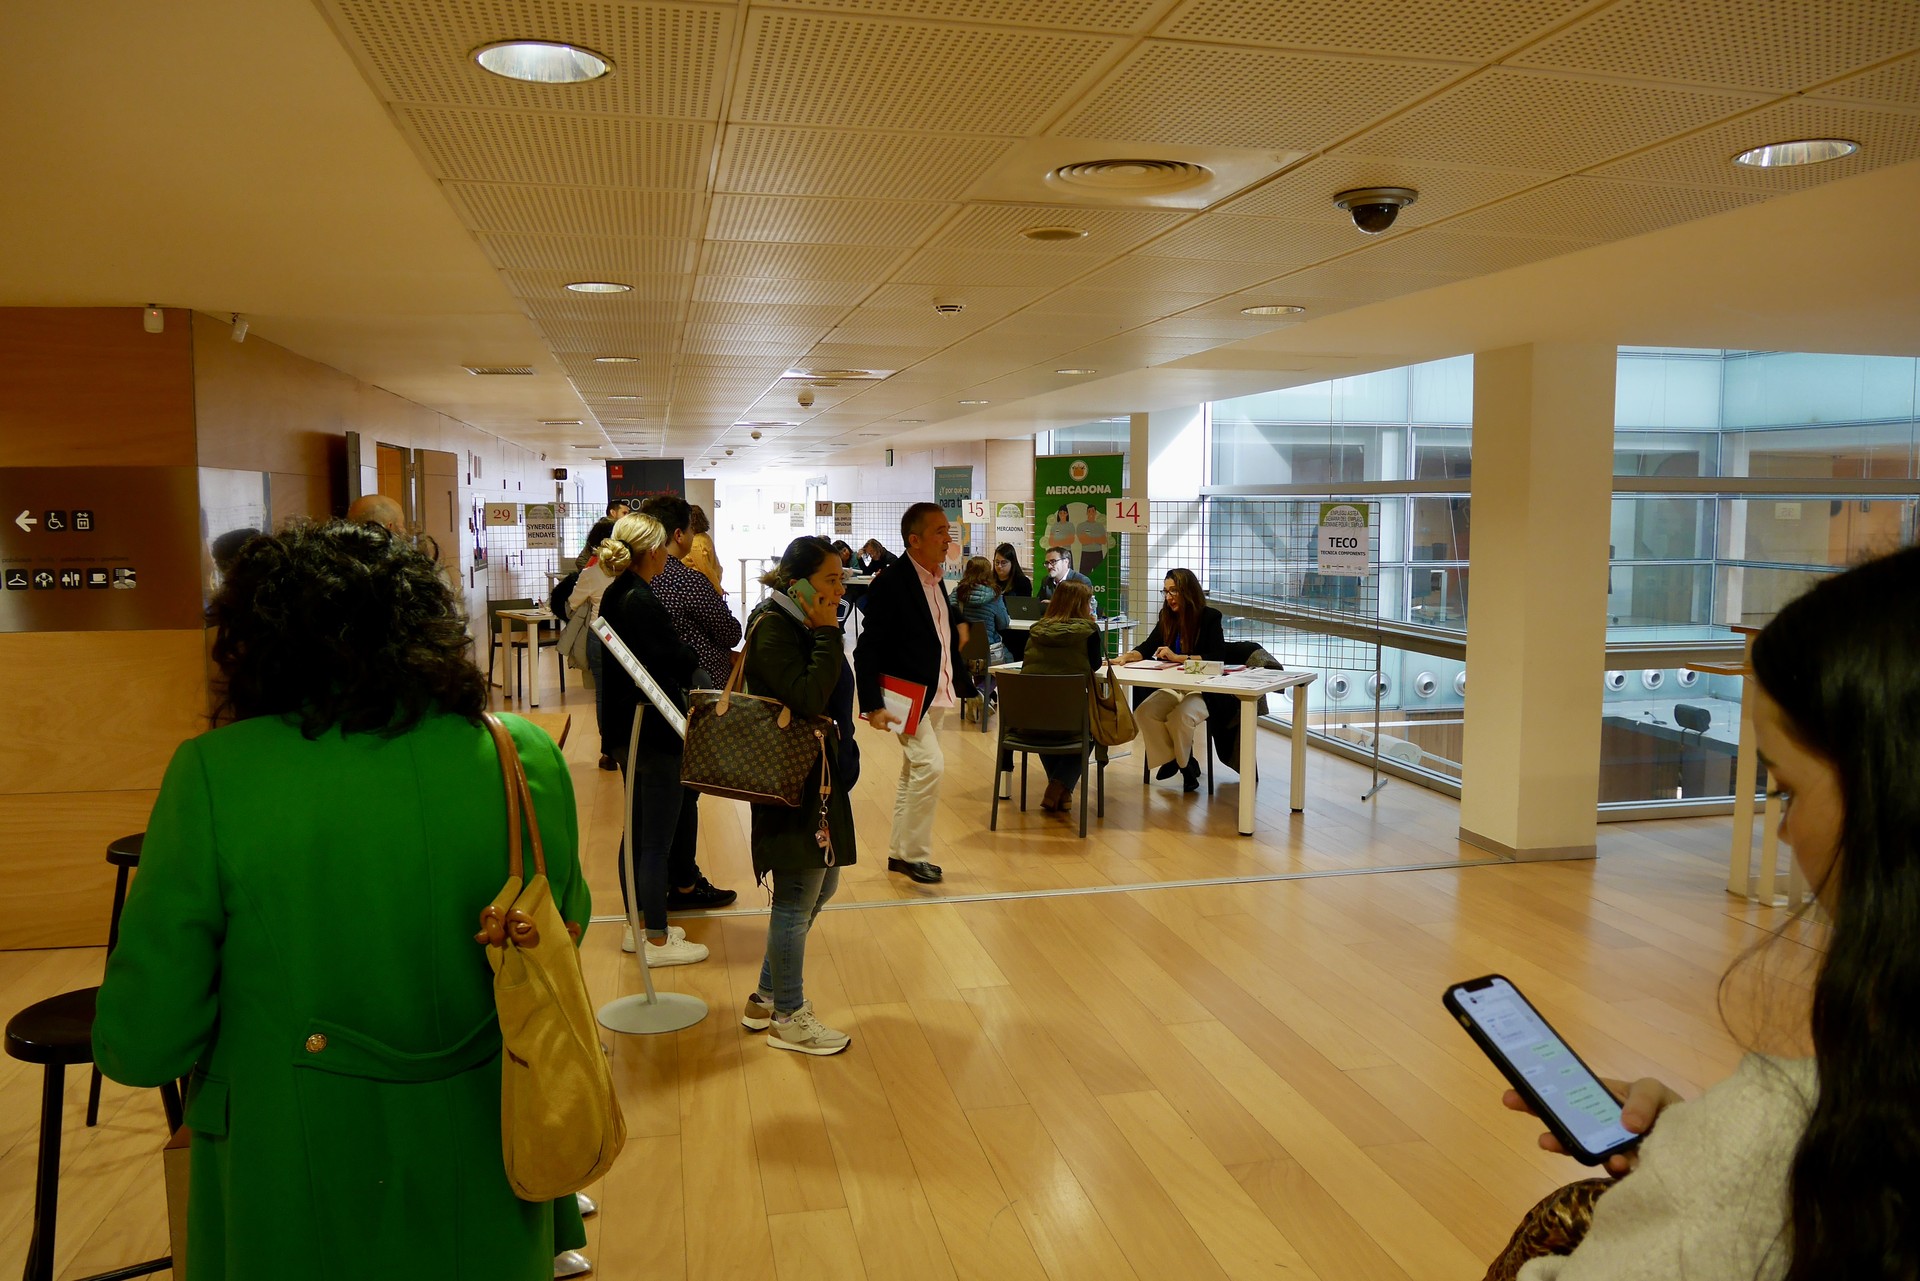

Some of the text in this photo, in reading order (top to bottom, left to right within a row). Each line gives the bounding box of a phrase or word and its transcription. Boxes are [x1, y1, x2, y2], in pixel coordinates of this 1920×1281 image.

[954, 486, 962, 495] qué
[1046, 485, 1111, 495] MERCADONA
[777, 503, 786, 511] 19
[940, 499, 955, 508] para
[819, 504, 828, 514] 17
[968, 502, 984, 517] 15
[1116, 502, 1140, 524] 14
[494, 509, 510, 521] 29
[1329, 537, 1358, 548] TECO
